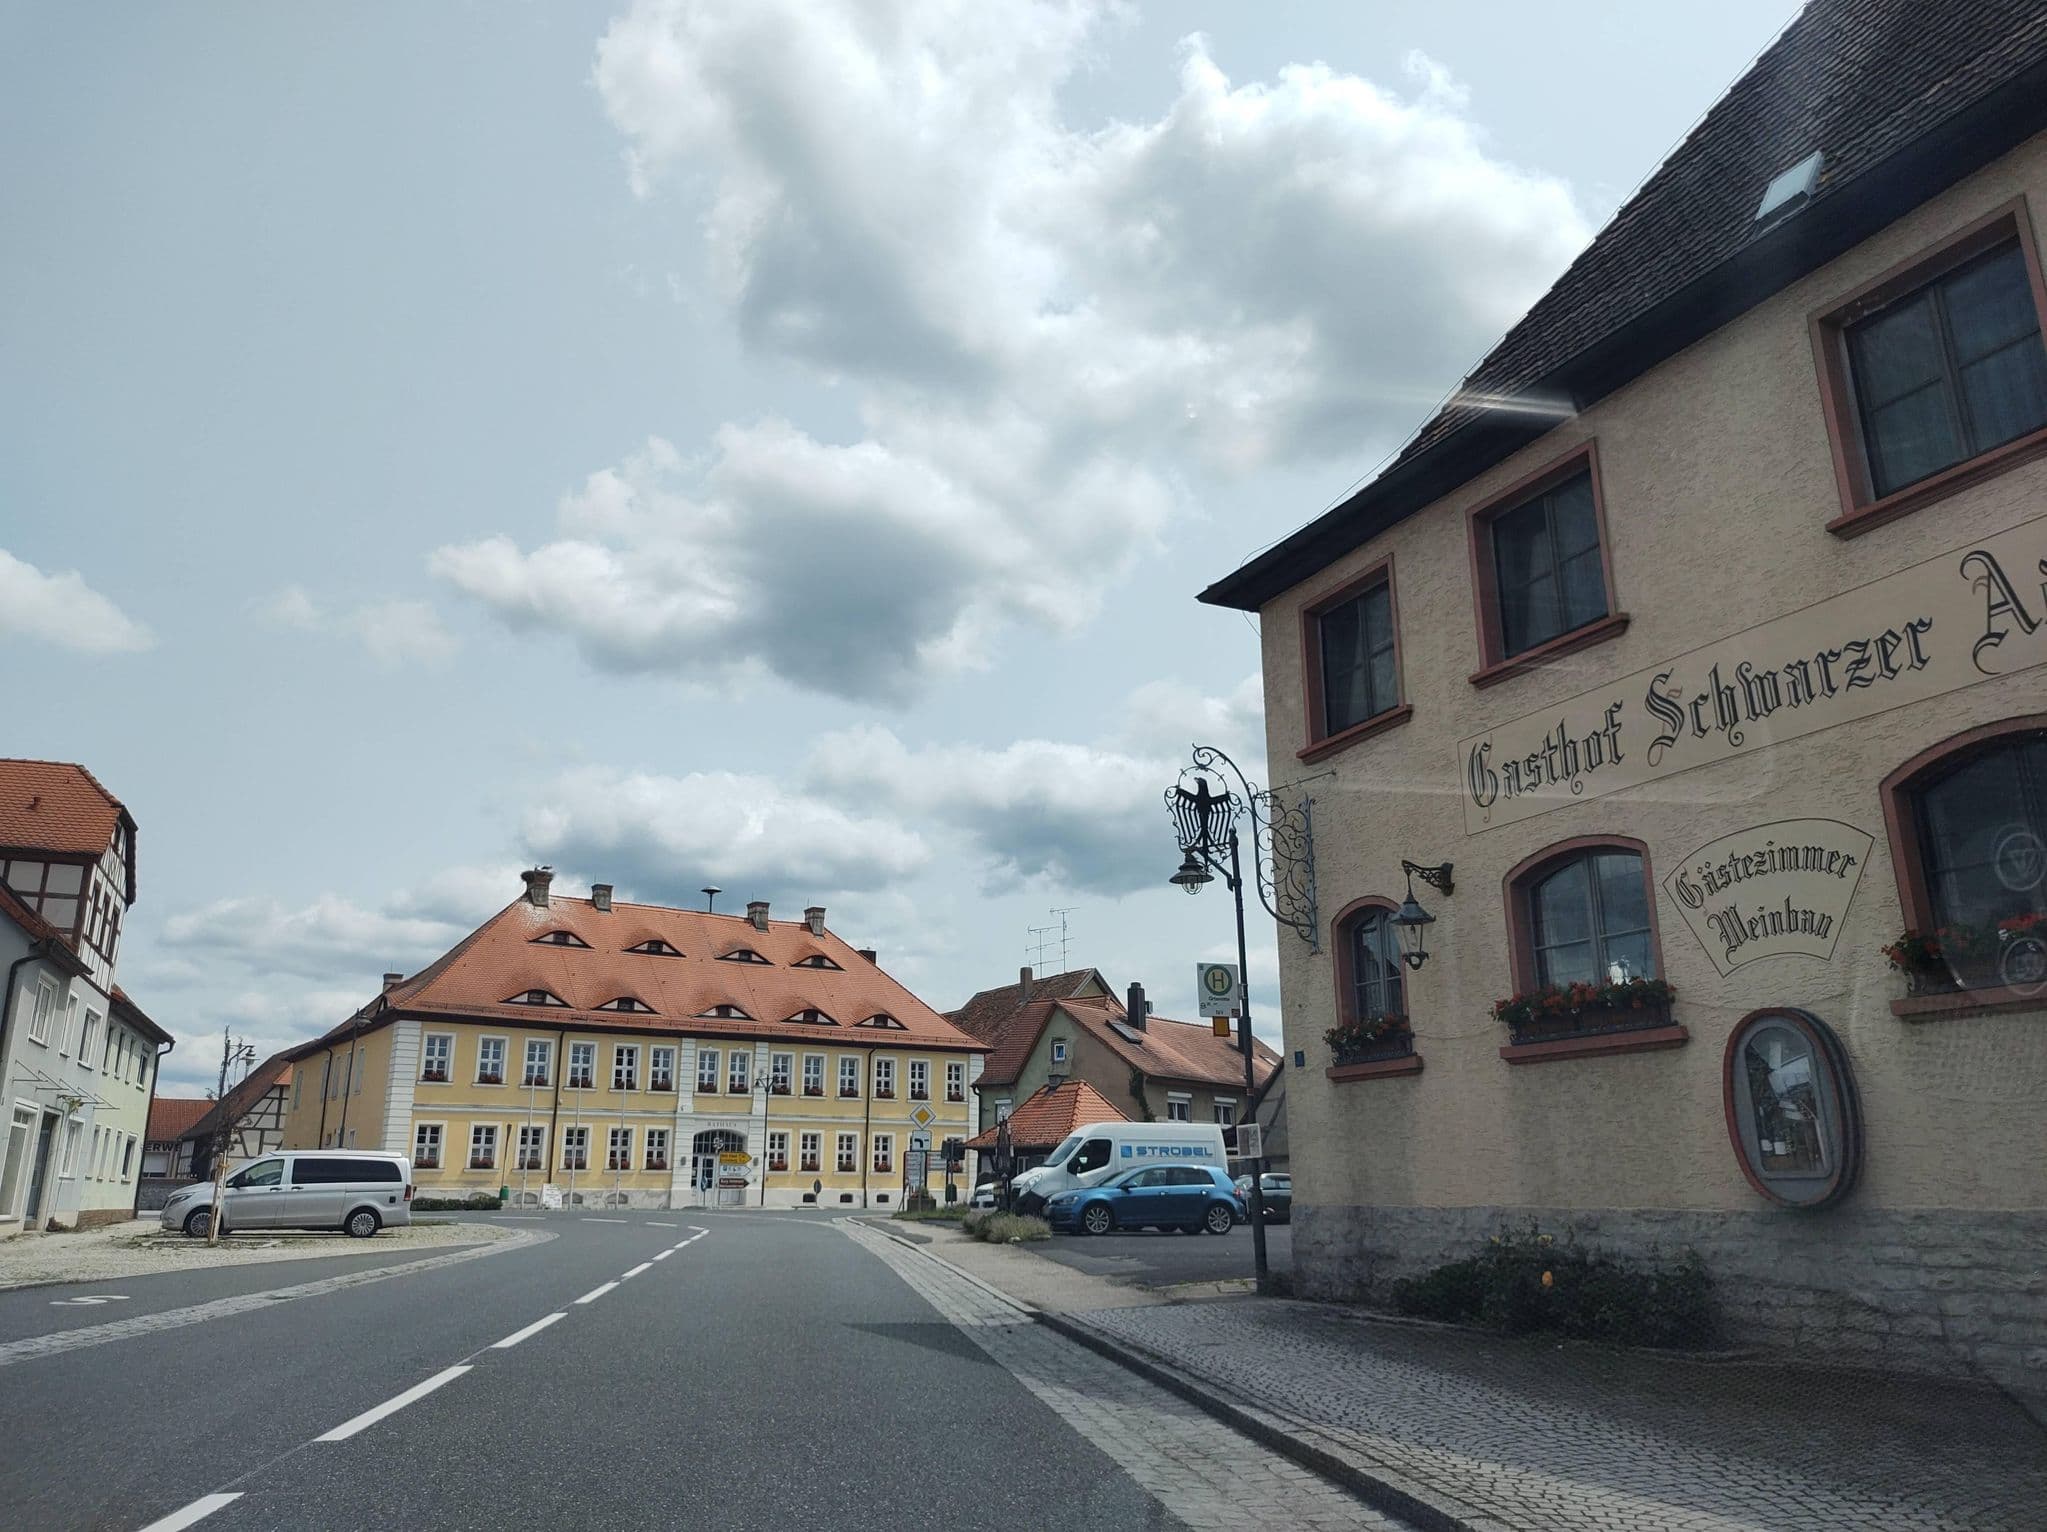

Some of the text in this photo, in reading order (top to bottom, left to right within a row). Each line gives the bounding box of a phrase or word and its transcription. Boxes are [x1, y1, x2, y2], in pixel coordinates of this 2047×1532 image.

[1468, 699, 1626, 820] Gasthof
[1644, 616, 1933, 768] Schwarzer
[1675, 841, 1858, 910] Gästezimmer
[1706, 895, 1834, 965] Weinbau
[1211, 971, 1226, 989] H
[1136, 1145, 1213, 1156] STROBEL
